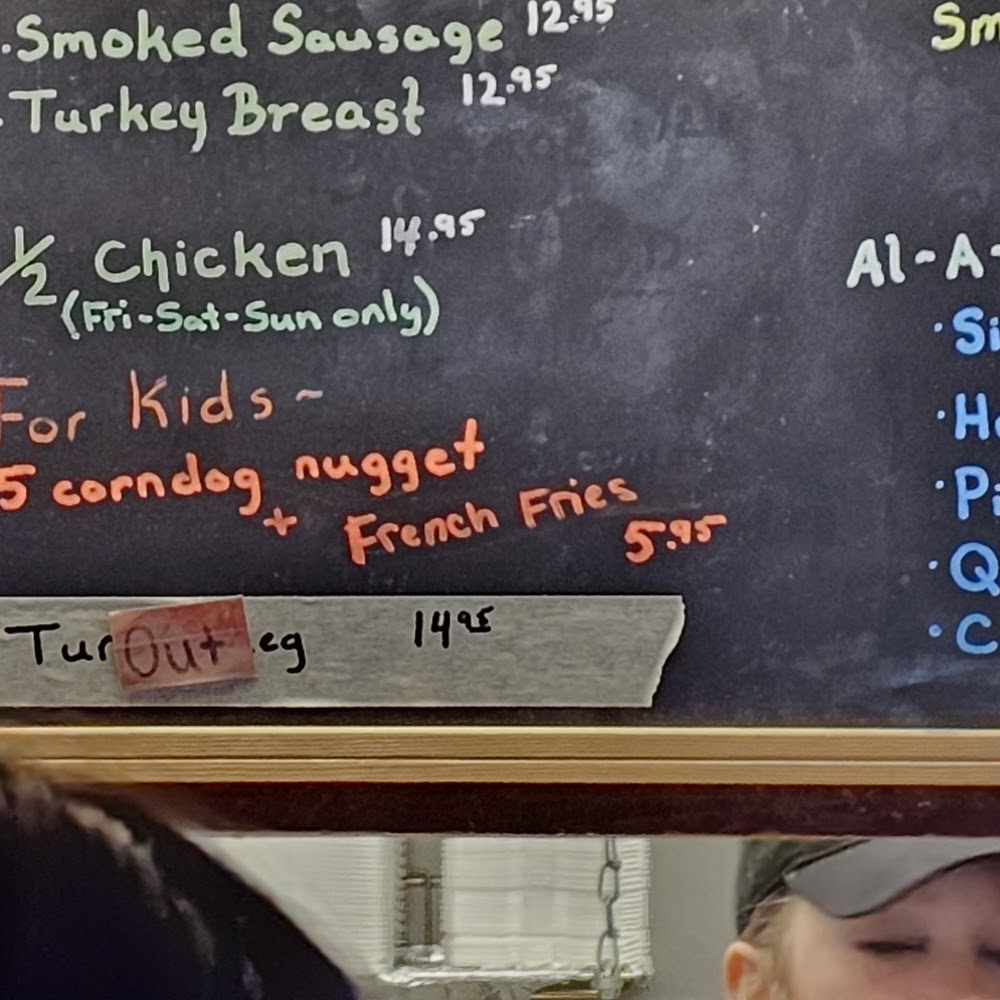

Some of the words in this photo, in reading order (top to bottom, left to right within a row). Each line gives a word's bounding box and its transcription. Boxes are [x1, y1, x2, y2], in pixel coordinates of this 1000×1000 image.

[17, 4, 248, 62] Smoked
[268, 4, 505, 66] Sausage
[8, 86, 207, 153] Turkey
[222, 76, 426, 136] Breast
[462, 64, 557, 106] 12.95
[95, 232, 350, 293] Chicken
[380, 209, 485, 255] 14.95
[61, 291, 323, 340] (Fri-Sat-Sun
[332, 276, 440, 337] only)
[130, 369, 274, 430] Kids
[52, 454, 263, 515] corndog
[295, 418, 485, 496] nugget
[346, 501, 500, 566] French
[519, 477, 639, 528] Fries
[624, 514, 727, 563] 5.95
[123, 624, 228, 680] Out
